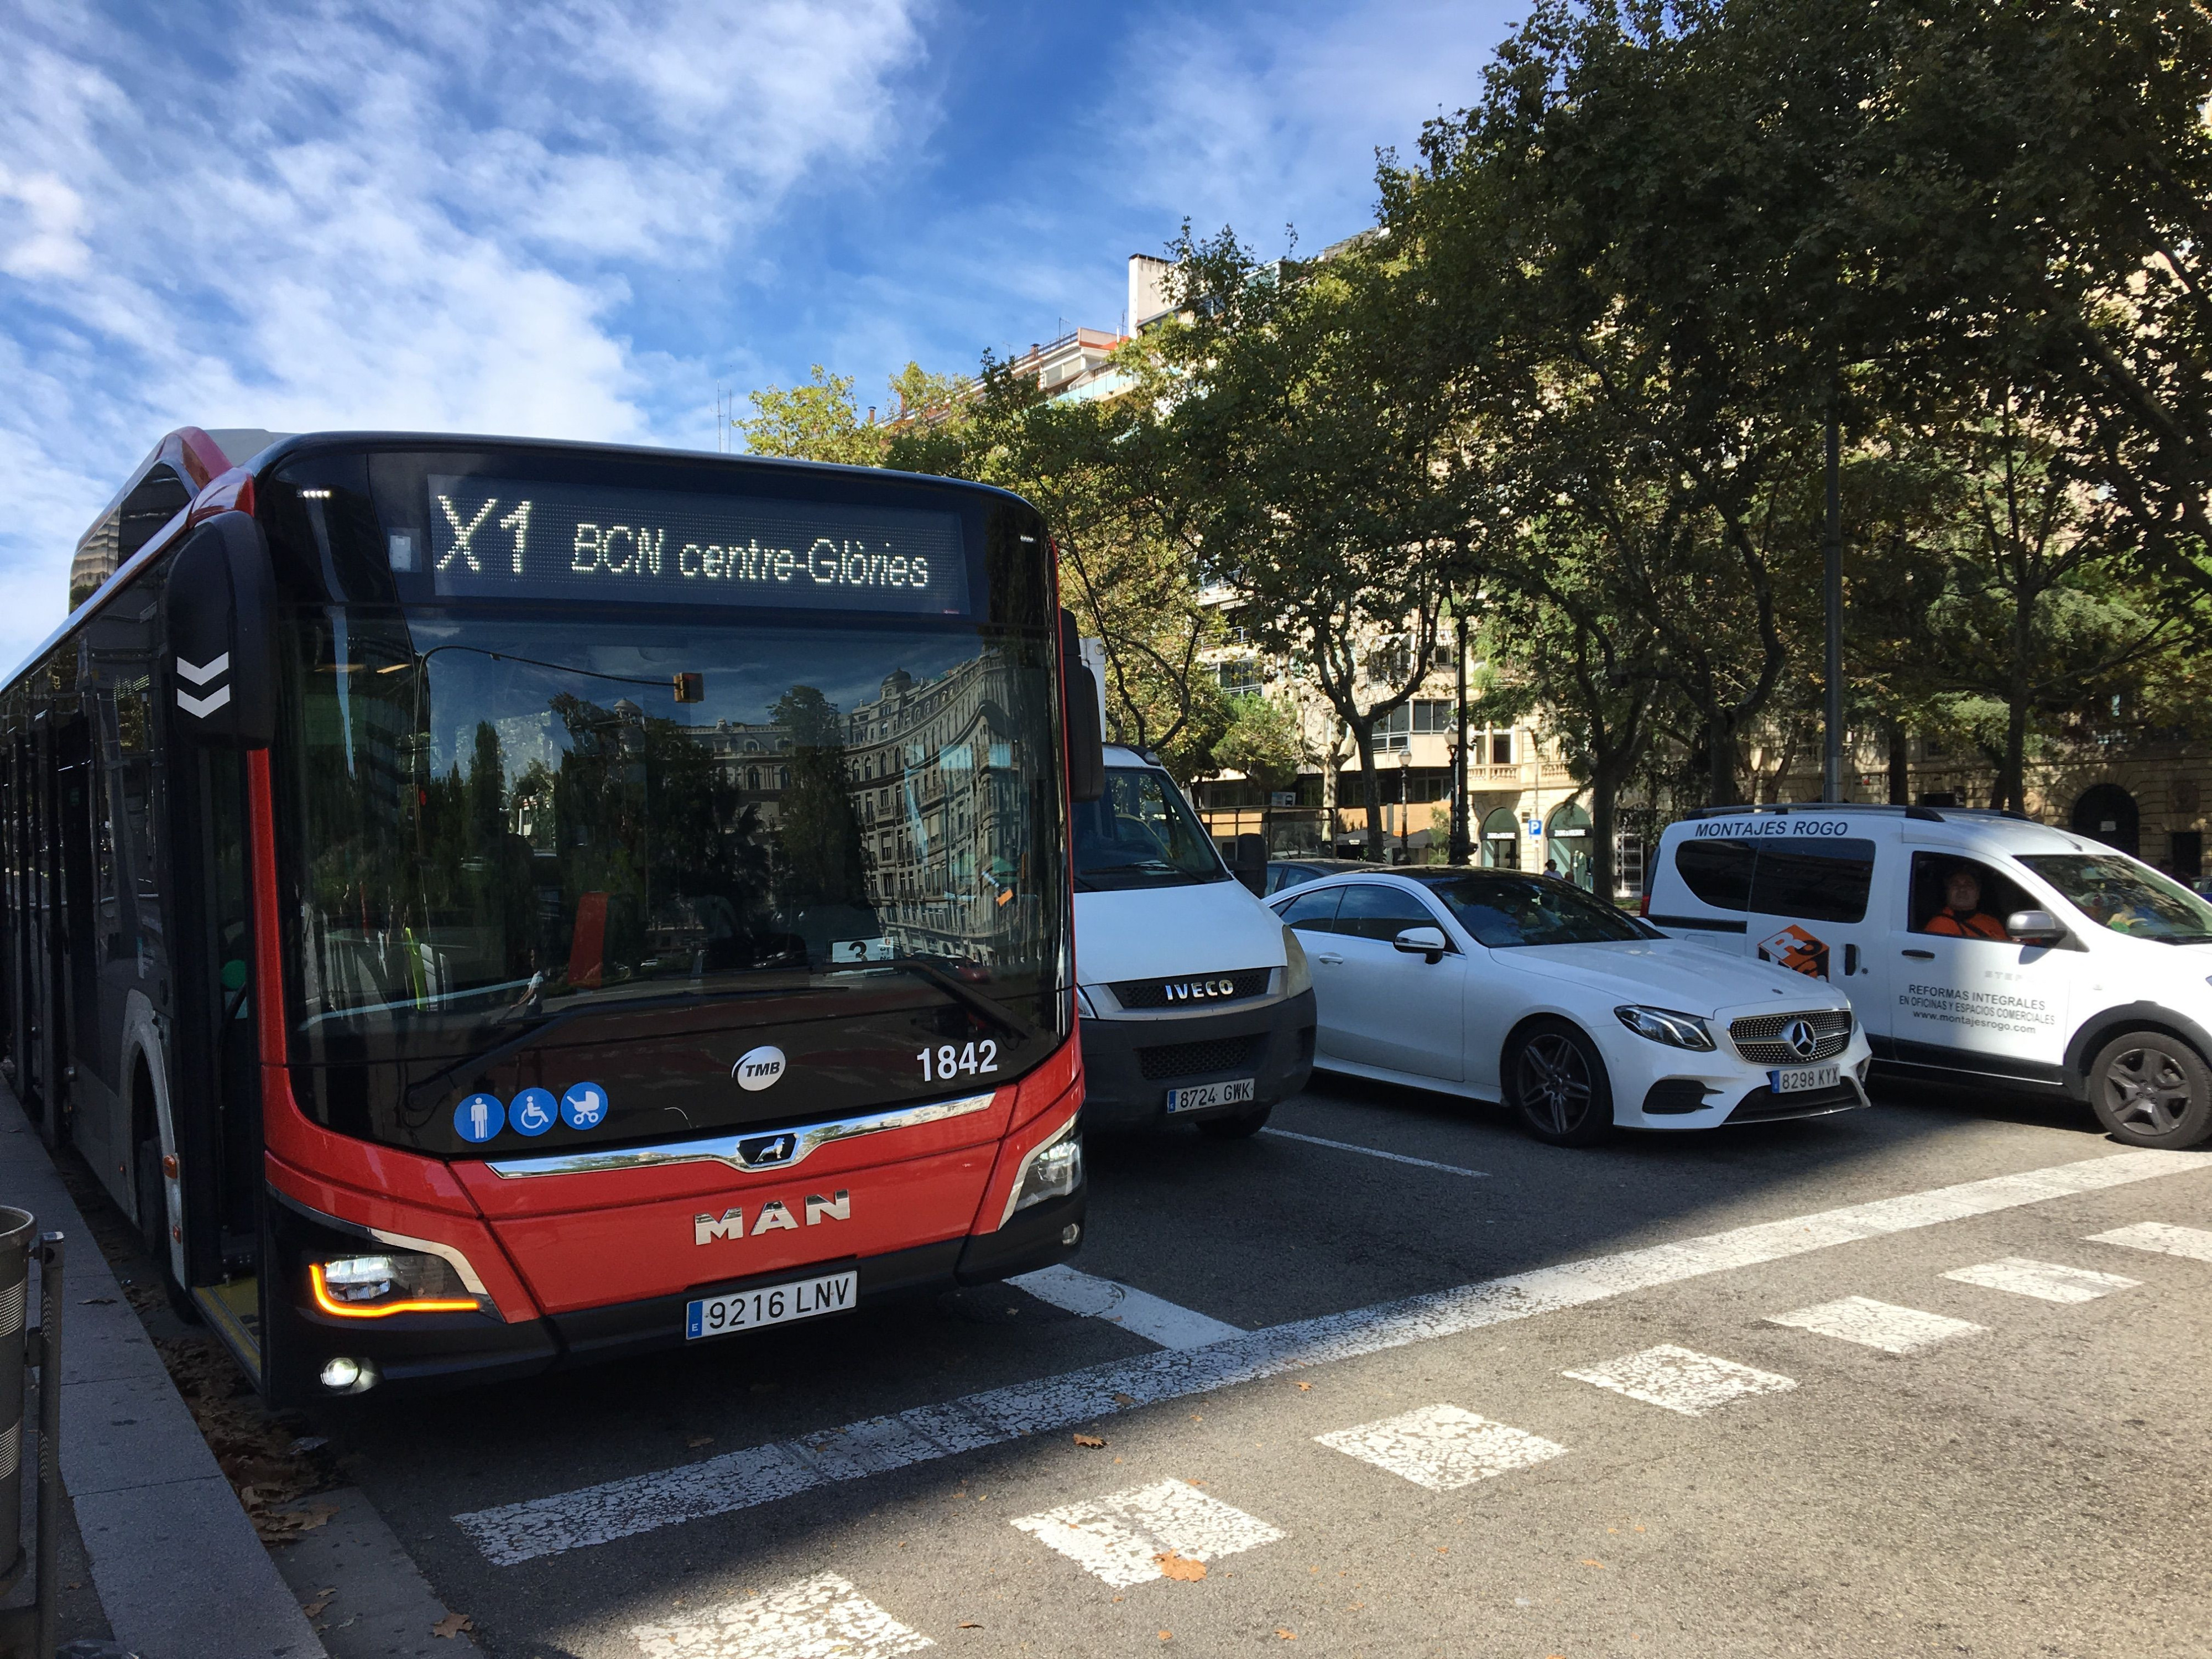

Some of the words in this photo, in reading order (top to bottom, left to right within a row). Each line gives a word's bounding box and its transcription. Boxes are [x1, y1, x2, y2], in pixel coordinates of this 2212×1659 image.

[436, 495, 532, 573] X1
[571, 523, 664, 575] BCN
[680, 538, 928, 587] centre-Glòries
[1531, 821, 1540, 833] P
[1694, 821, 1787, 837] MONTAJES
[1793, 821, 1848, 836] ROGO
[1165, 979, 1234, 1000] IVECO
[1909, 984, 1969, 1000] REFORMAS
[1972, 992, 2046, 1010] INTEGRALES
[1899, 995, 1910, 1005] EN
[1911, 996, 1948, 1010] OFICINAS
[1948, 1001, 1953, 1011] Y
[1955, 1003, 1995, 1017] ESPACIOS
[1997, 1008, 2056, 1025] COMERCIALES
[1913, 1011, 2036, 1034] www.montajesrogo.com
[745, 1061, 780, 1078] TMB
[916, 1040, 998, 1082] 1842
[1782, 1071, 1814, 1090] 8298
[1818, 1067, 1838, 1086] KYX
[1180, 1087, 1217, 1108] 8724
[1224, 1082, 1250, 1101] GWK
[694, 1189, 851, 1245] MAN
[691, 1323, 698, 1332] E
[709, 1291, 785, 1329] 9216
[796, 1277, 849, 1313] LNV
